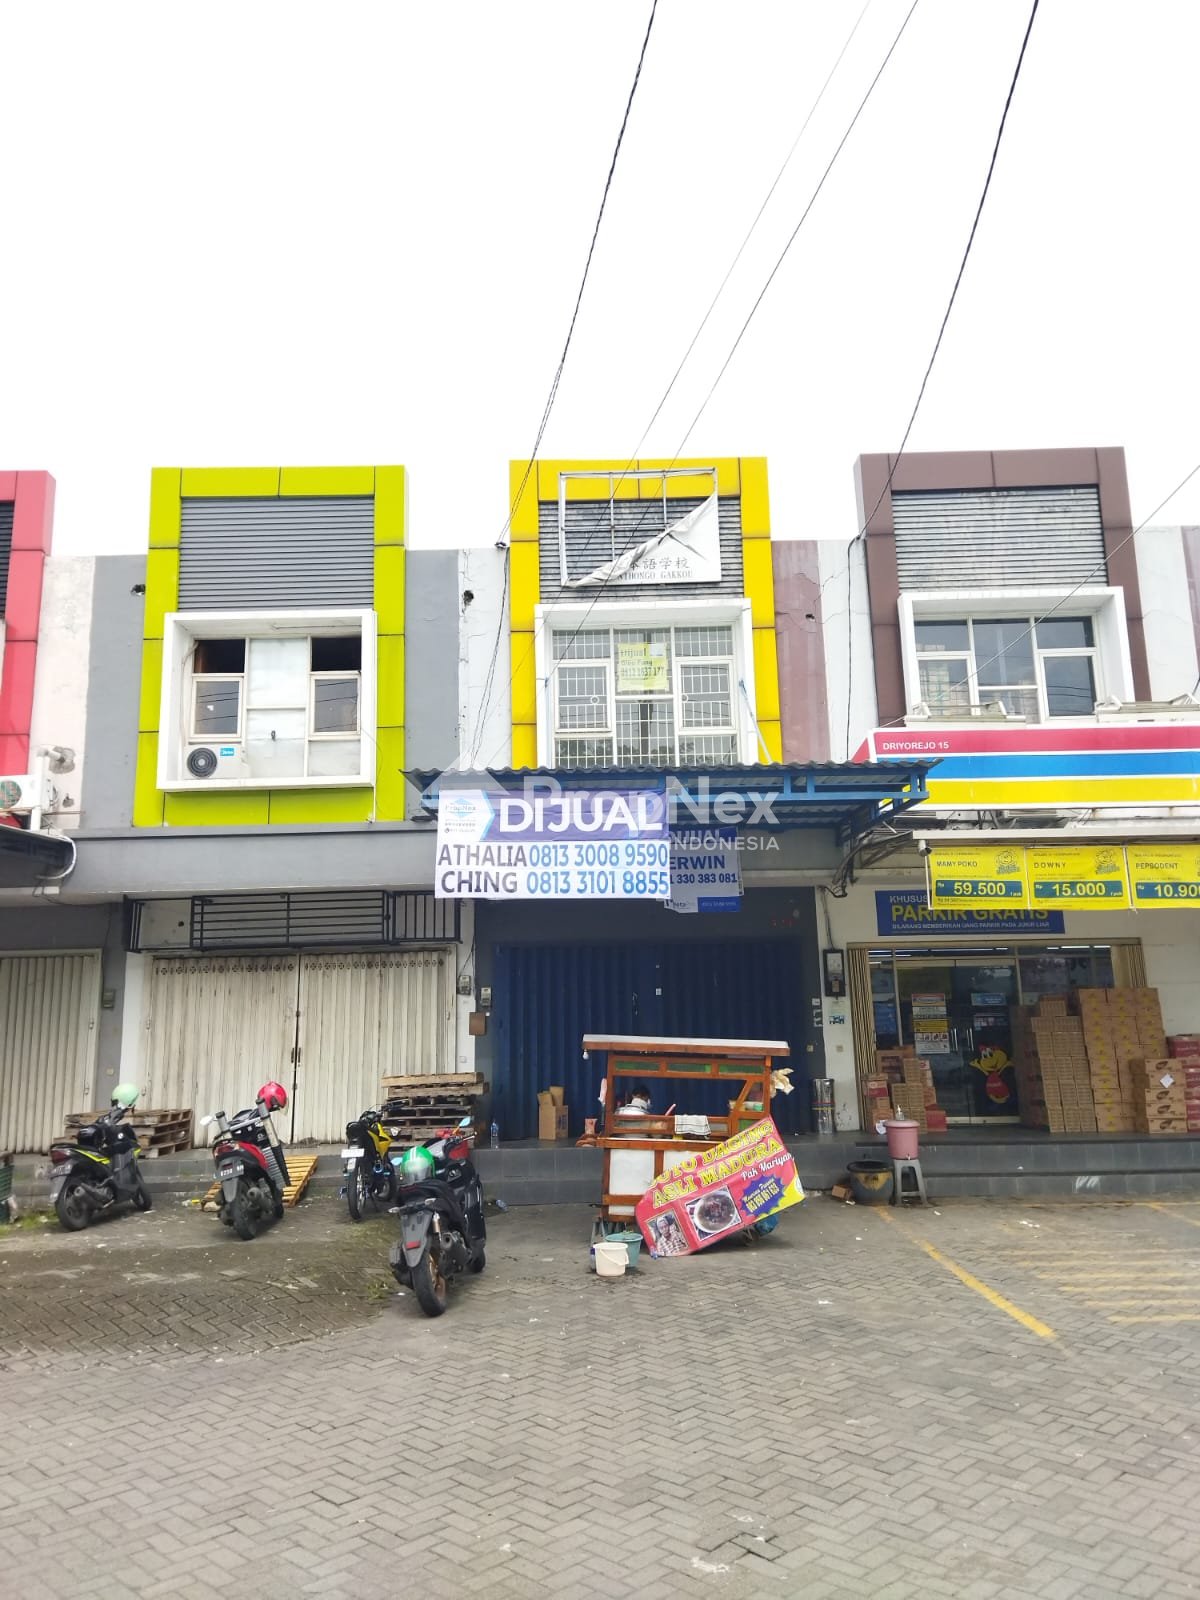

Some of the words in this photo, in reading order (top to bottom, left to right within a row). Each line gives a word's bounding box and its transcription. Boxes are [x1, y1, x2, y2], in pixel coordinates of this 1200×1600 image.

[882, 740, 937, 751] DRIYOREJO
[938, 740, 949, 750] 15
[499, 797, 663, 833] DIJUAL
[438, 844, 527, 867] ATHALIA
[529, 844, 568, 867] 0813
[574, 844, 620, 867] 3008
[625, 844, 669, 867] 9590
[957, 860, 978, 868] POKO
[1033, 861, 1067, 869] DOWNY
[1135, 862, 1179, 870] PEPSODENT
[441, 870, 518, 894] CHING
[527, 871, 568, 895] 0813
[577, 871, 616, 895] 3101
[623, 871, 669, 895] 8855
[677, 873, 695, 885] 330
[698, 873, 717, 884] 383
[719, 872, 738, 884] 081
[953, 881, 1006, 896] 59.500
[1051, 882, 1106, 897] 15.000
[889, 895, 928, 903] KHUSUS
[891, 904, 966, 922] PARKIR
[654, 1174, 697, 1208] ASLI
[698, 1136, 785, 1188] MADURA
[740, 1166, 759, 1181] Pak
